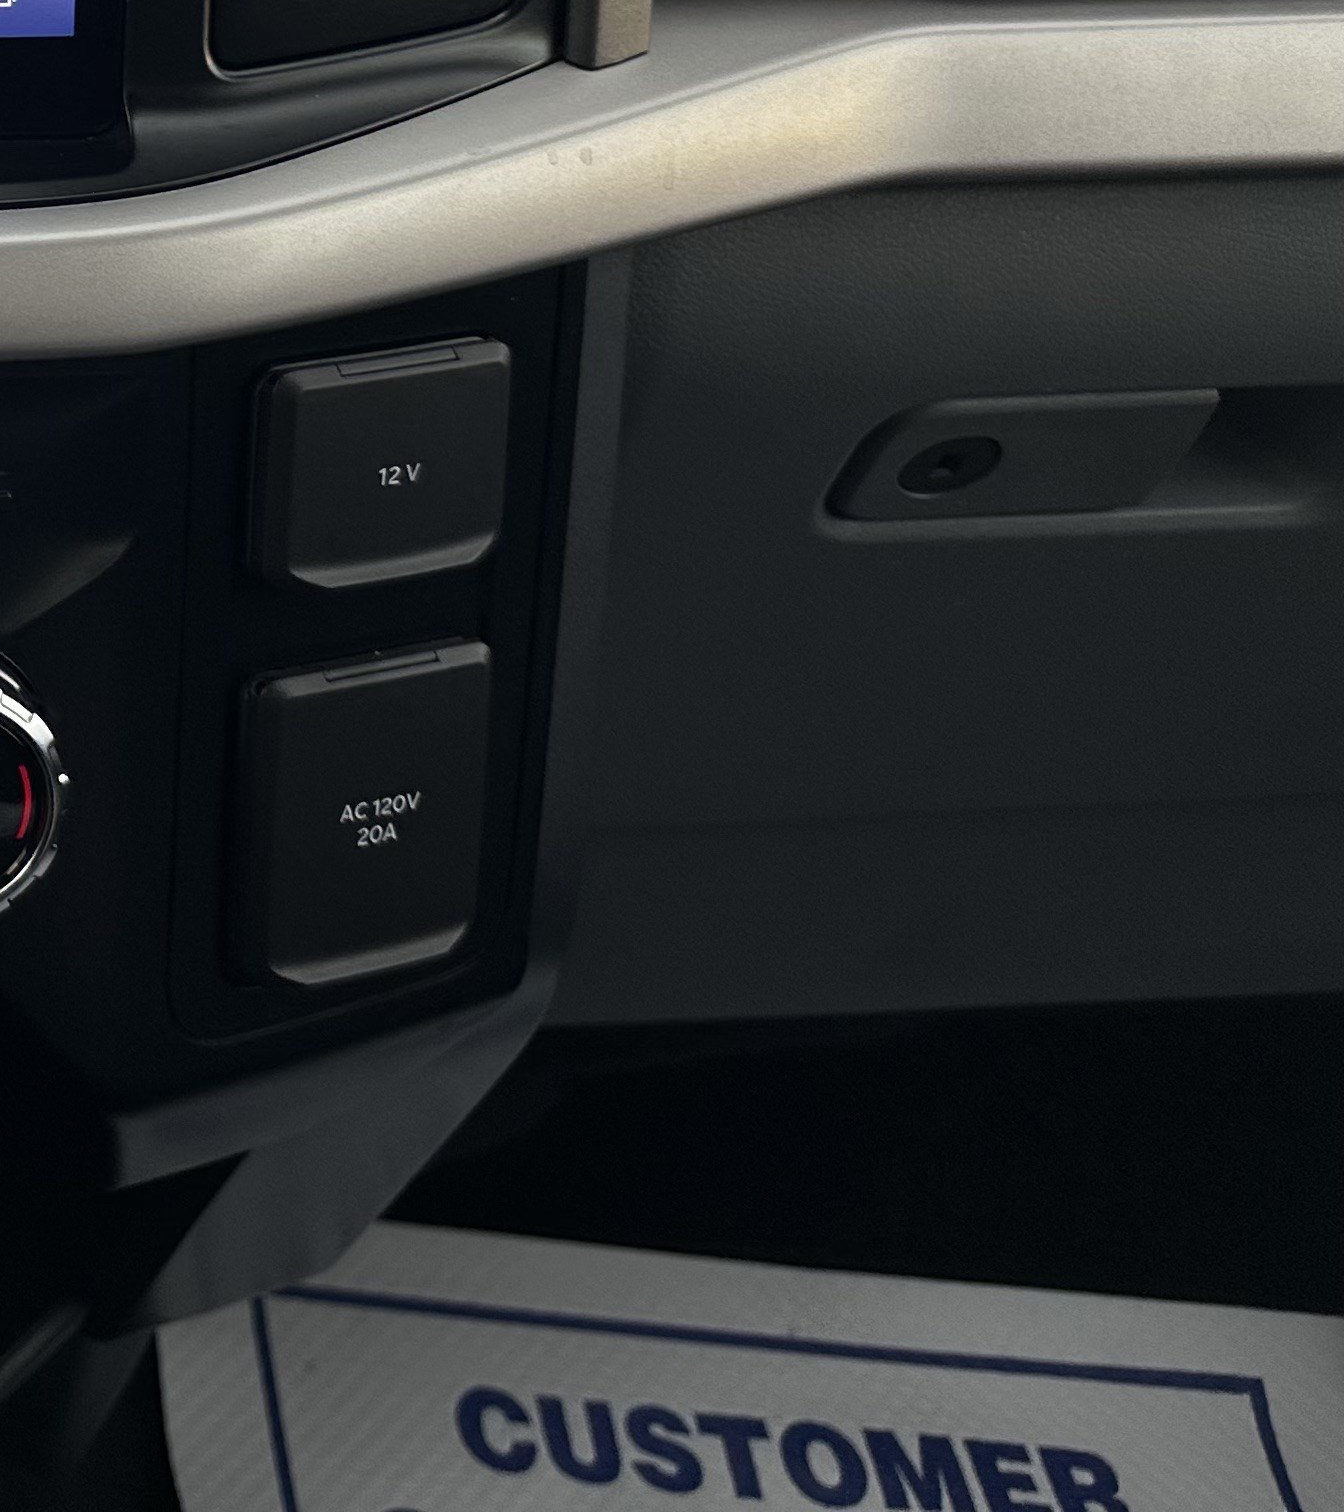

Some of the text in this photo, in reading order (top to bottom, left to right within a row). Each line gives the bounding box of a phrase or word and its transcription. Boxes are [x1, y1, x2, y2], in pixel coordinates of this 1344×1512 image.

[378, 462, 422, 487] 12 V
[340, 791, 422, 823] AC 120V
[357, 822, 397, 847] 20A
[455, 1384, 1130, 1512] CUSTOMER
